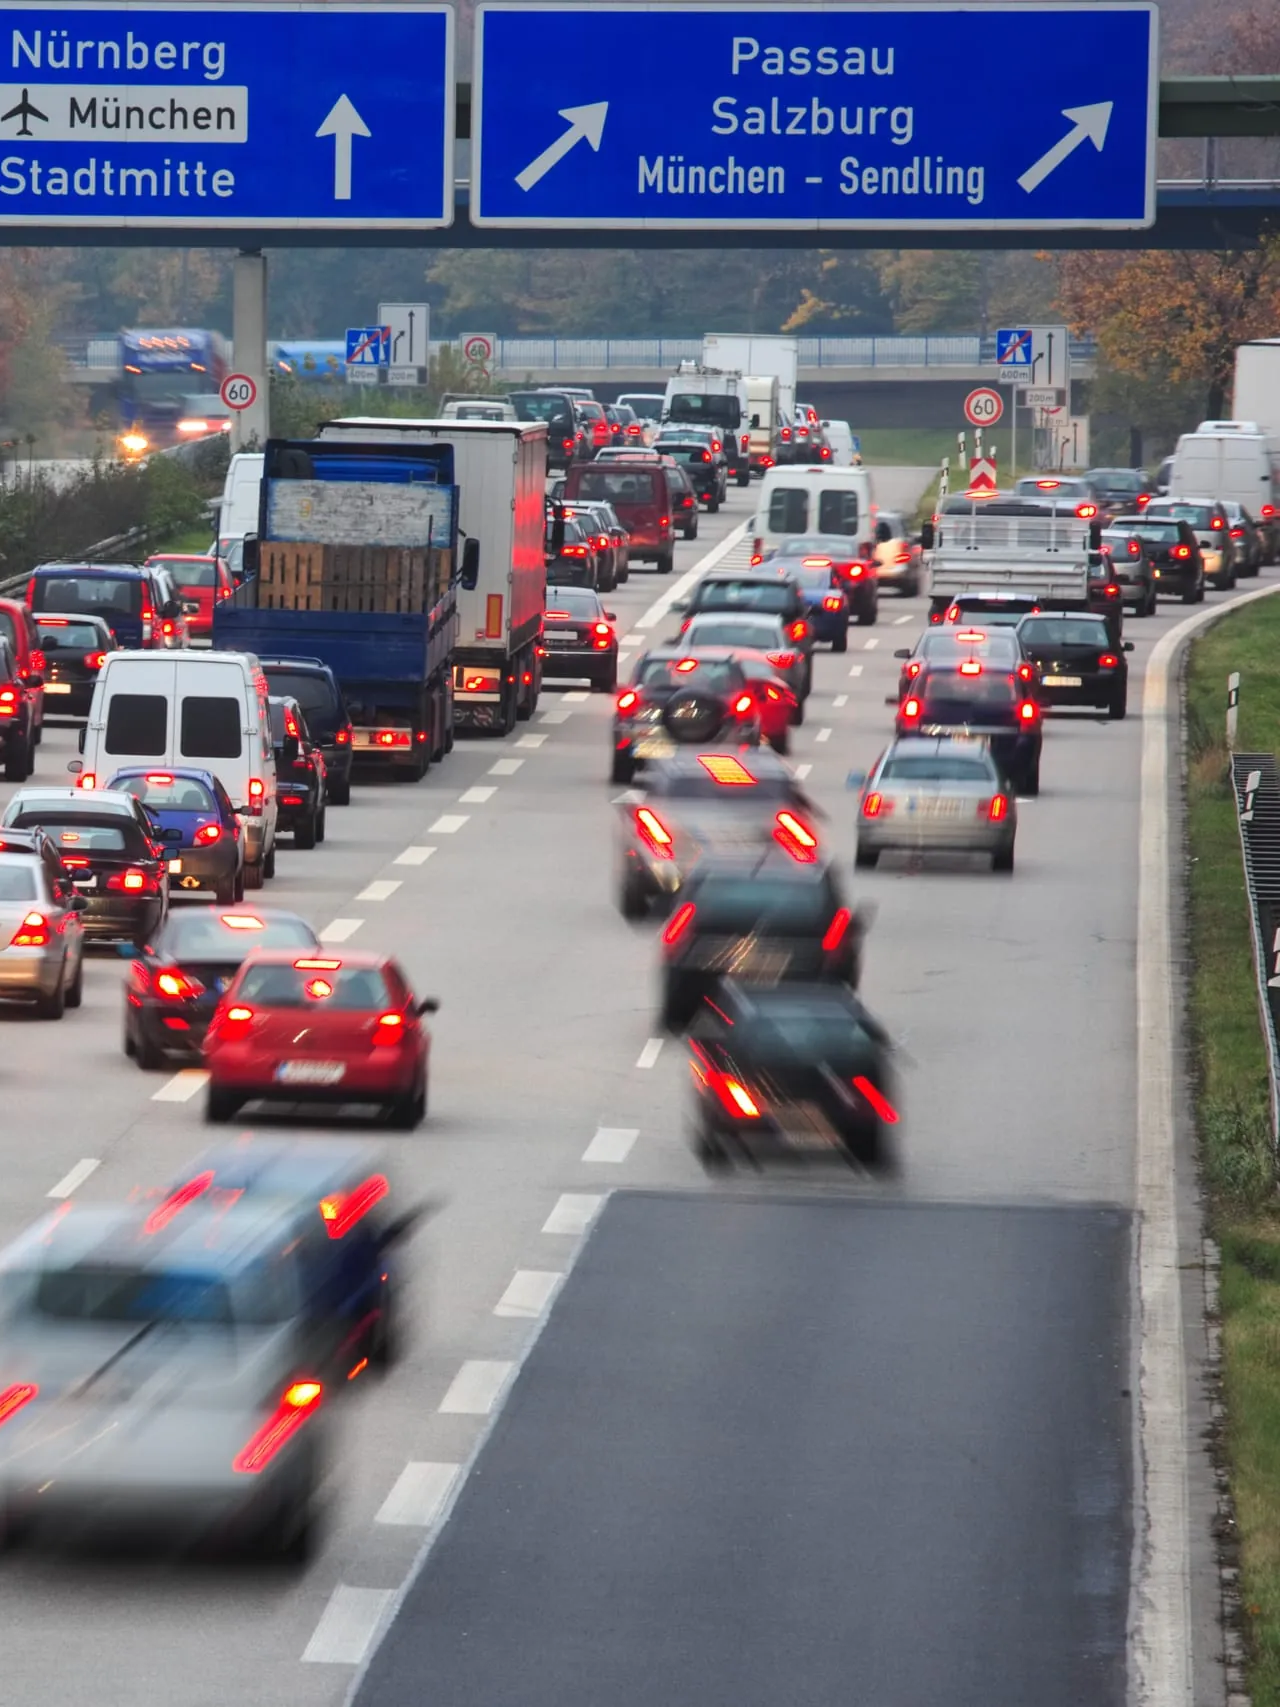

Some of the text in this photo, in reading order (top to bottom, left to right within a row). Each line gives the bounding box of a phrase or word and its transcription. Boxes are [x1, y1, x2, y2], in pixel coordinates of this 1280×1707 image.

[11, 30, 227, 80] Nürnberg
[732, 37, 895, 76] Passau
[69, 97, 236, 131] München
[711, 97, 914, 145] Salzburg
[0, 156, 236, 198] Stadtmitte
[637, 156, 786, 195] München
[839, 156, 985, 204] Sendling
[229, 384, 249, 400] 60
[973, 398, 994, 415] 60
